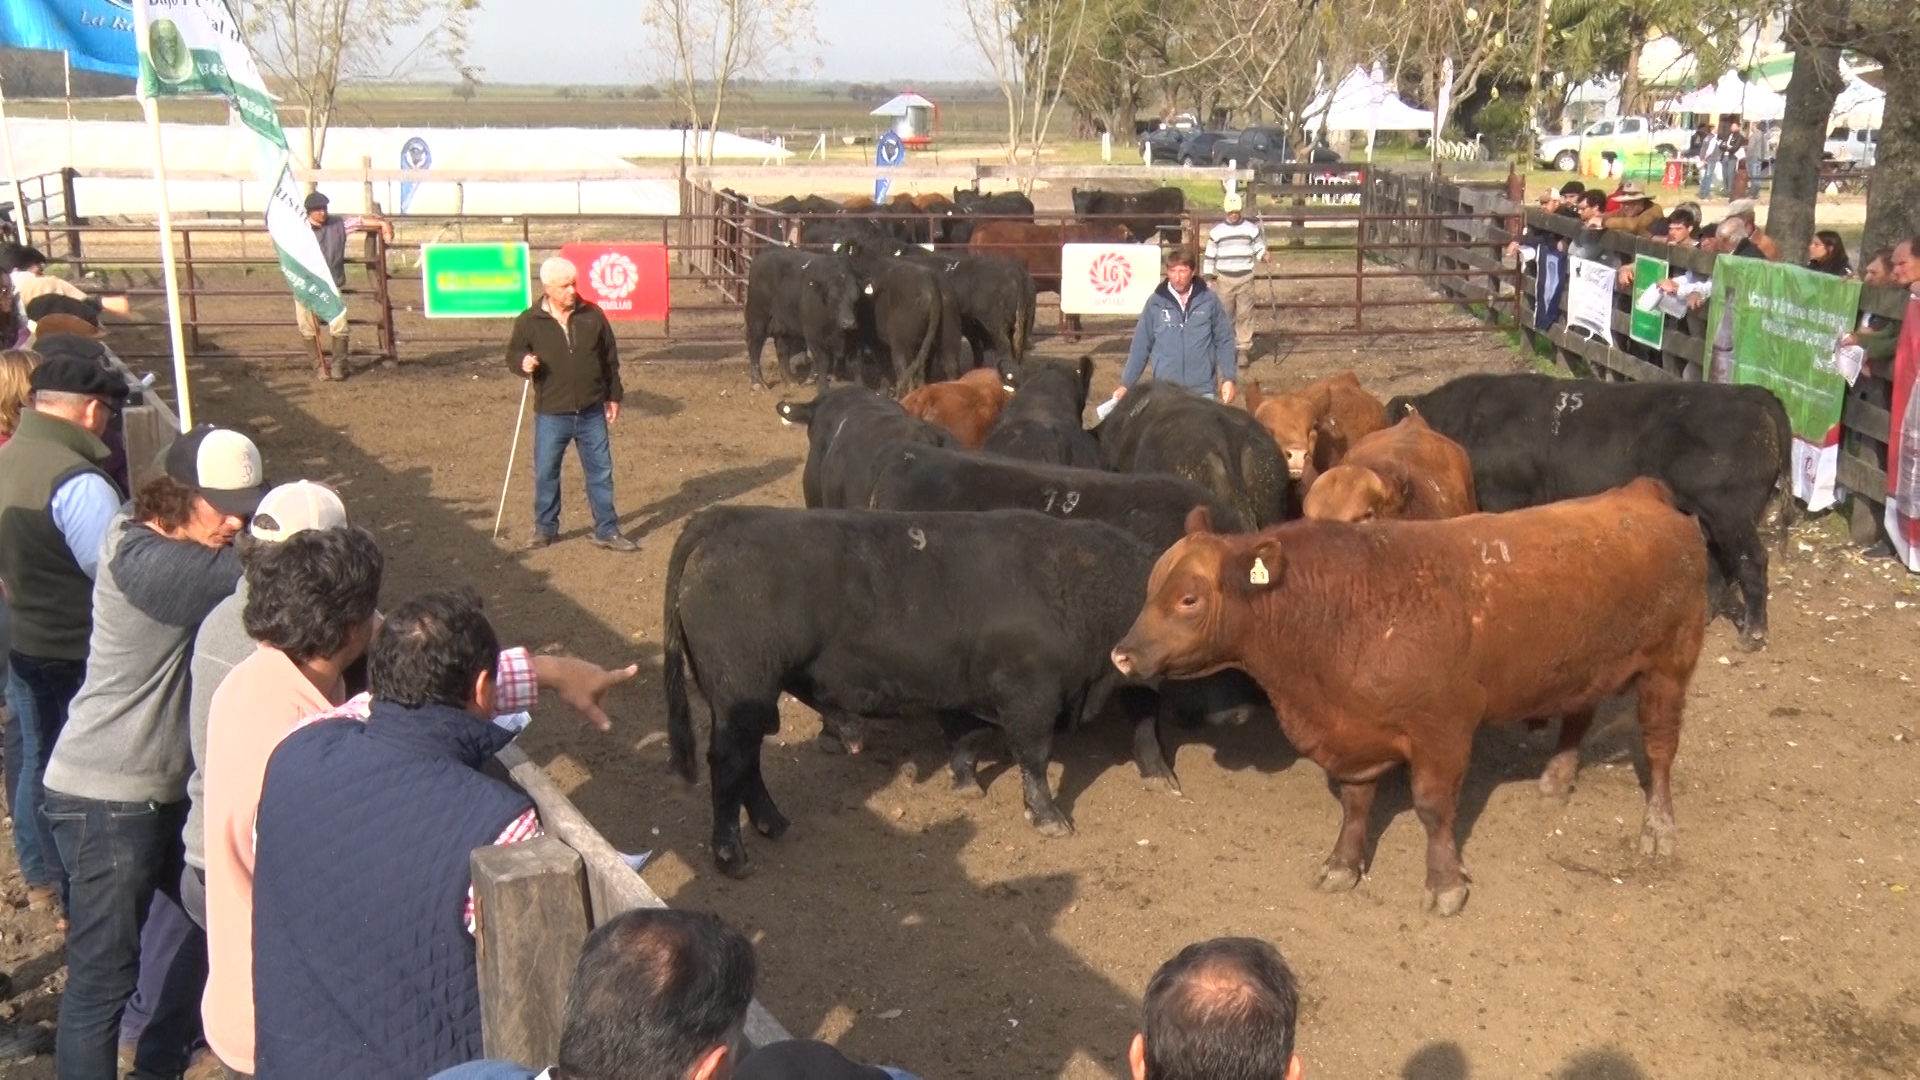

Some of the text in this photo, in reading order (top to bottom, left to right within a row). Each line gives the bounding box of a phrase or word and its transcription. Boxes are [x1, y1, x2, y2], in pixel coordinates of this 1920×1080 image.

[605, 265, 624, 286] LG
[1102, 265, 1119, 282] LG
[1555, 391, 1584, 413] 35
[907, 526, 927, 551] 9
